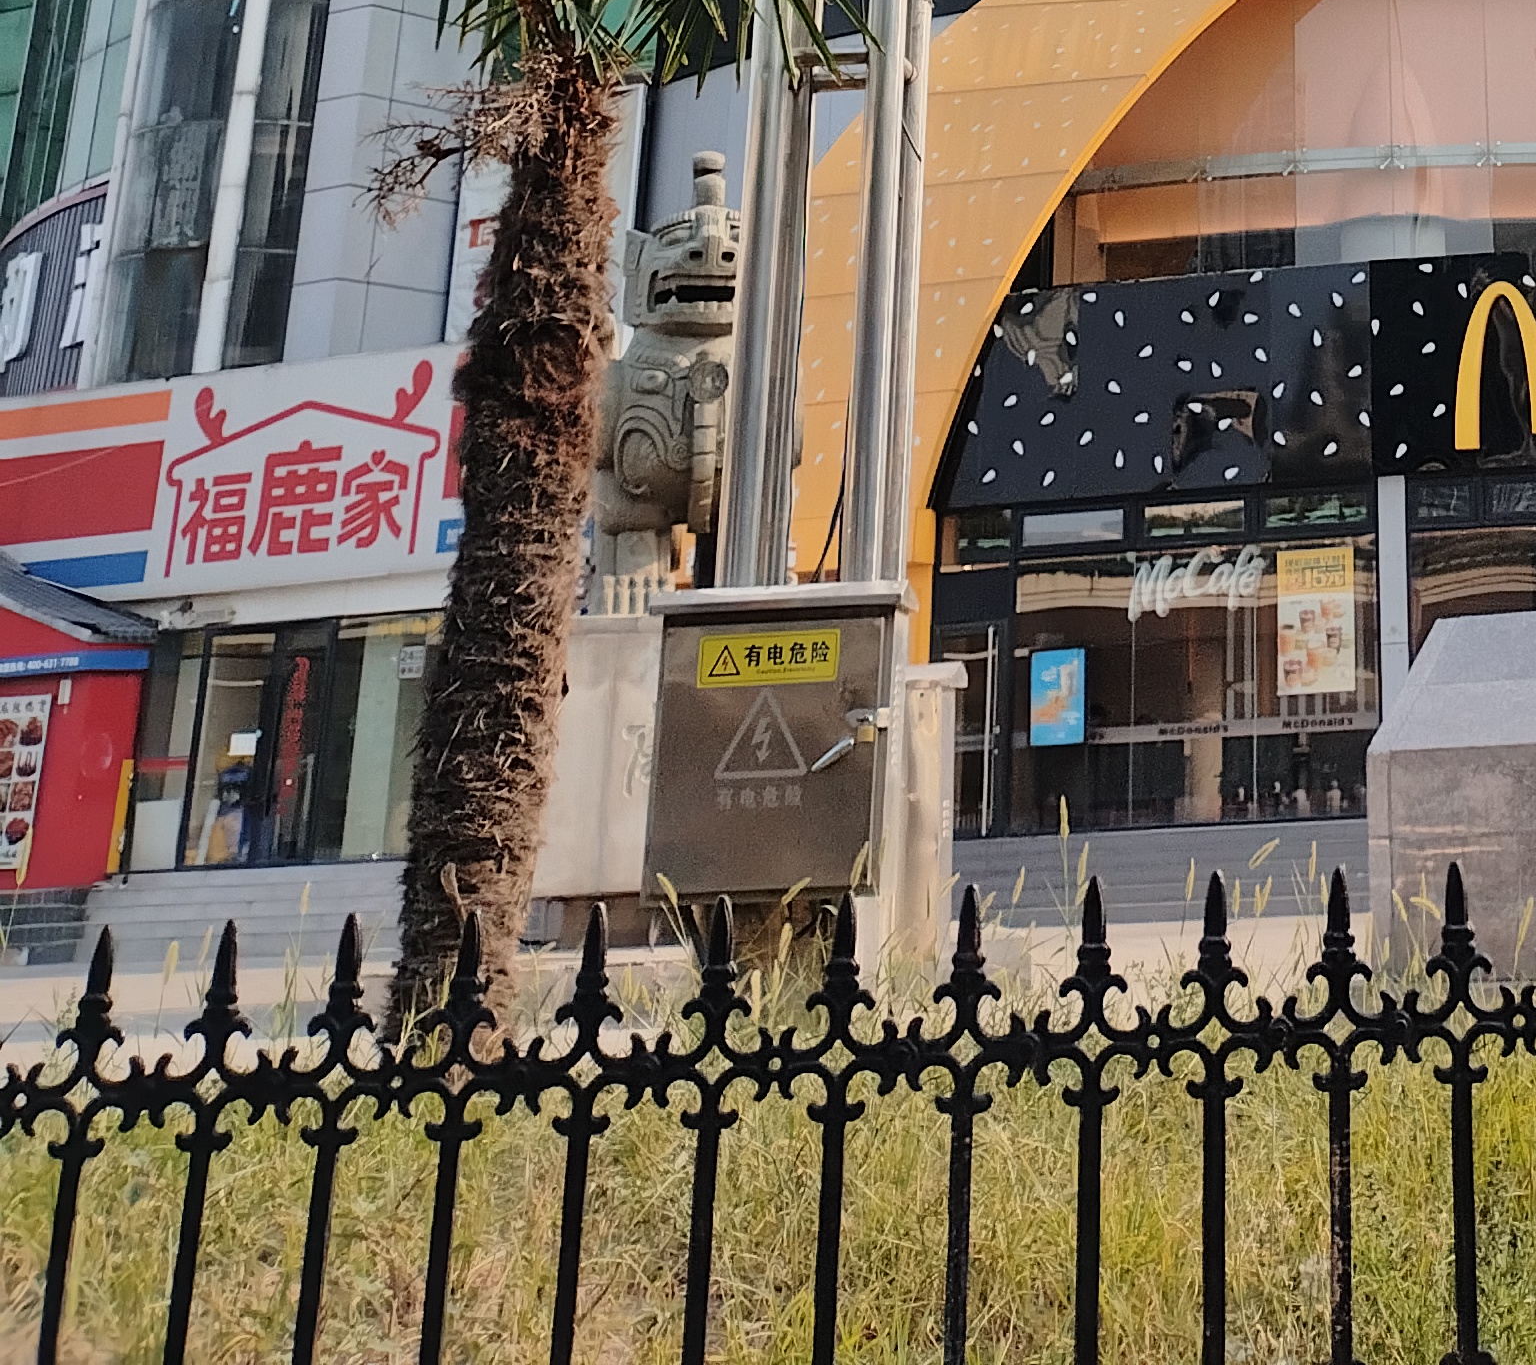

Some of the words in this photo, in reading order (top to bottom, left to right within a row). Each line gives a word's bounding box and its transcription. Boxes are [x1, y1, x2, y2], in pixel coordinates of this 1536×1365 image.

[181, 440, 409, 564] 福鹿家
[743, 640, 831, 668] 有电危险
